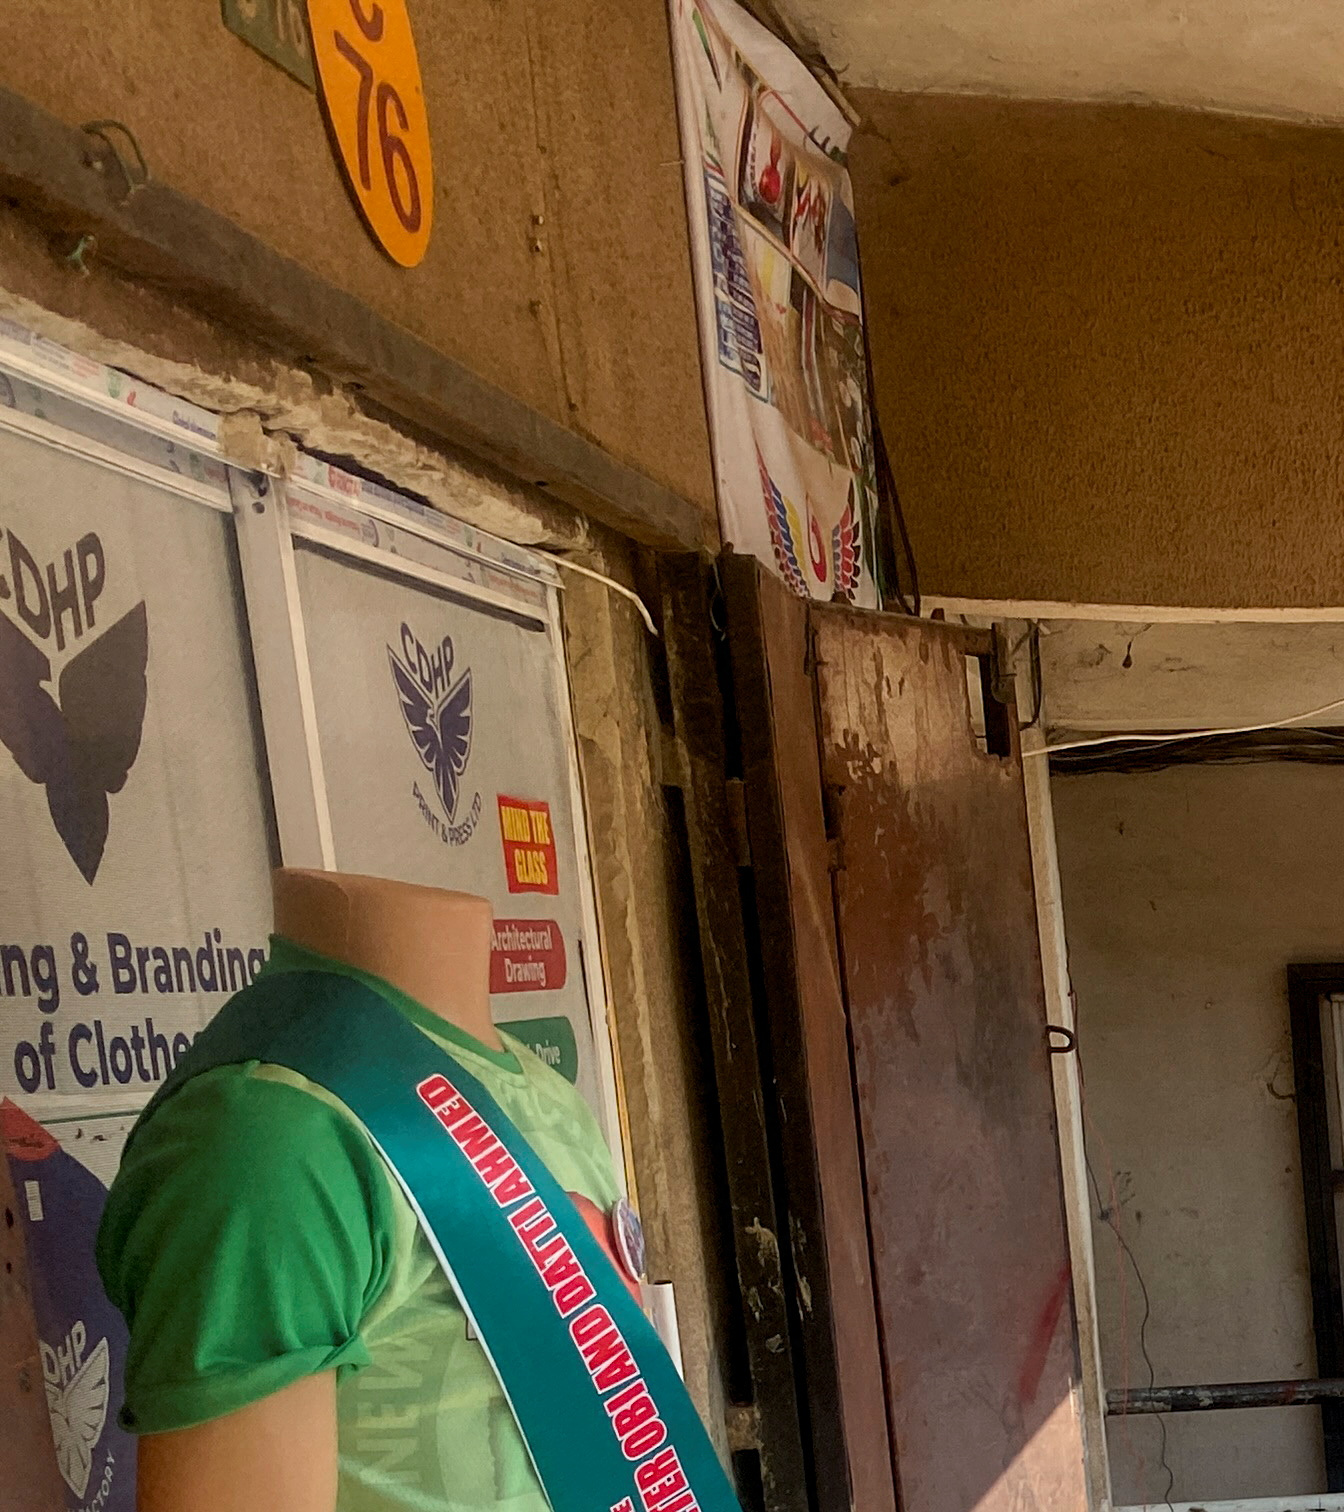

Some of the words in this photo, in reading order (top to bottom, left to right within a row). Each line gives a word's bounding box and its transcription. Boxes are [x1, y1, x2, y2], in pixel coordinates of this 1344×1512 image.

[334, 30, 422, 233] 76
[0, 527, 105, 651] DHP
[401, 622, 454, 699] CDHP
[501, 806, 531, 842] MIND
[530, 810, 550, 845] THE
[514, 847, 547, 886] GLASS
[70, 932, 99, 996] &
[492, 924, 552, 951] Architectural
[504, 956, 546, 987] Drawing
[15, 1021, 56, 1093] of
[416, 1073, 534, 1209] AHMED
[506, 1195, 597, 1319] DATTI
[568, 1303, 641, 1395] AND
[604, 1378, 668, 1461] OBI
